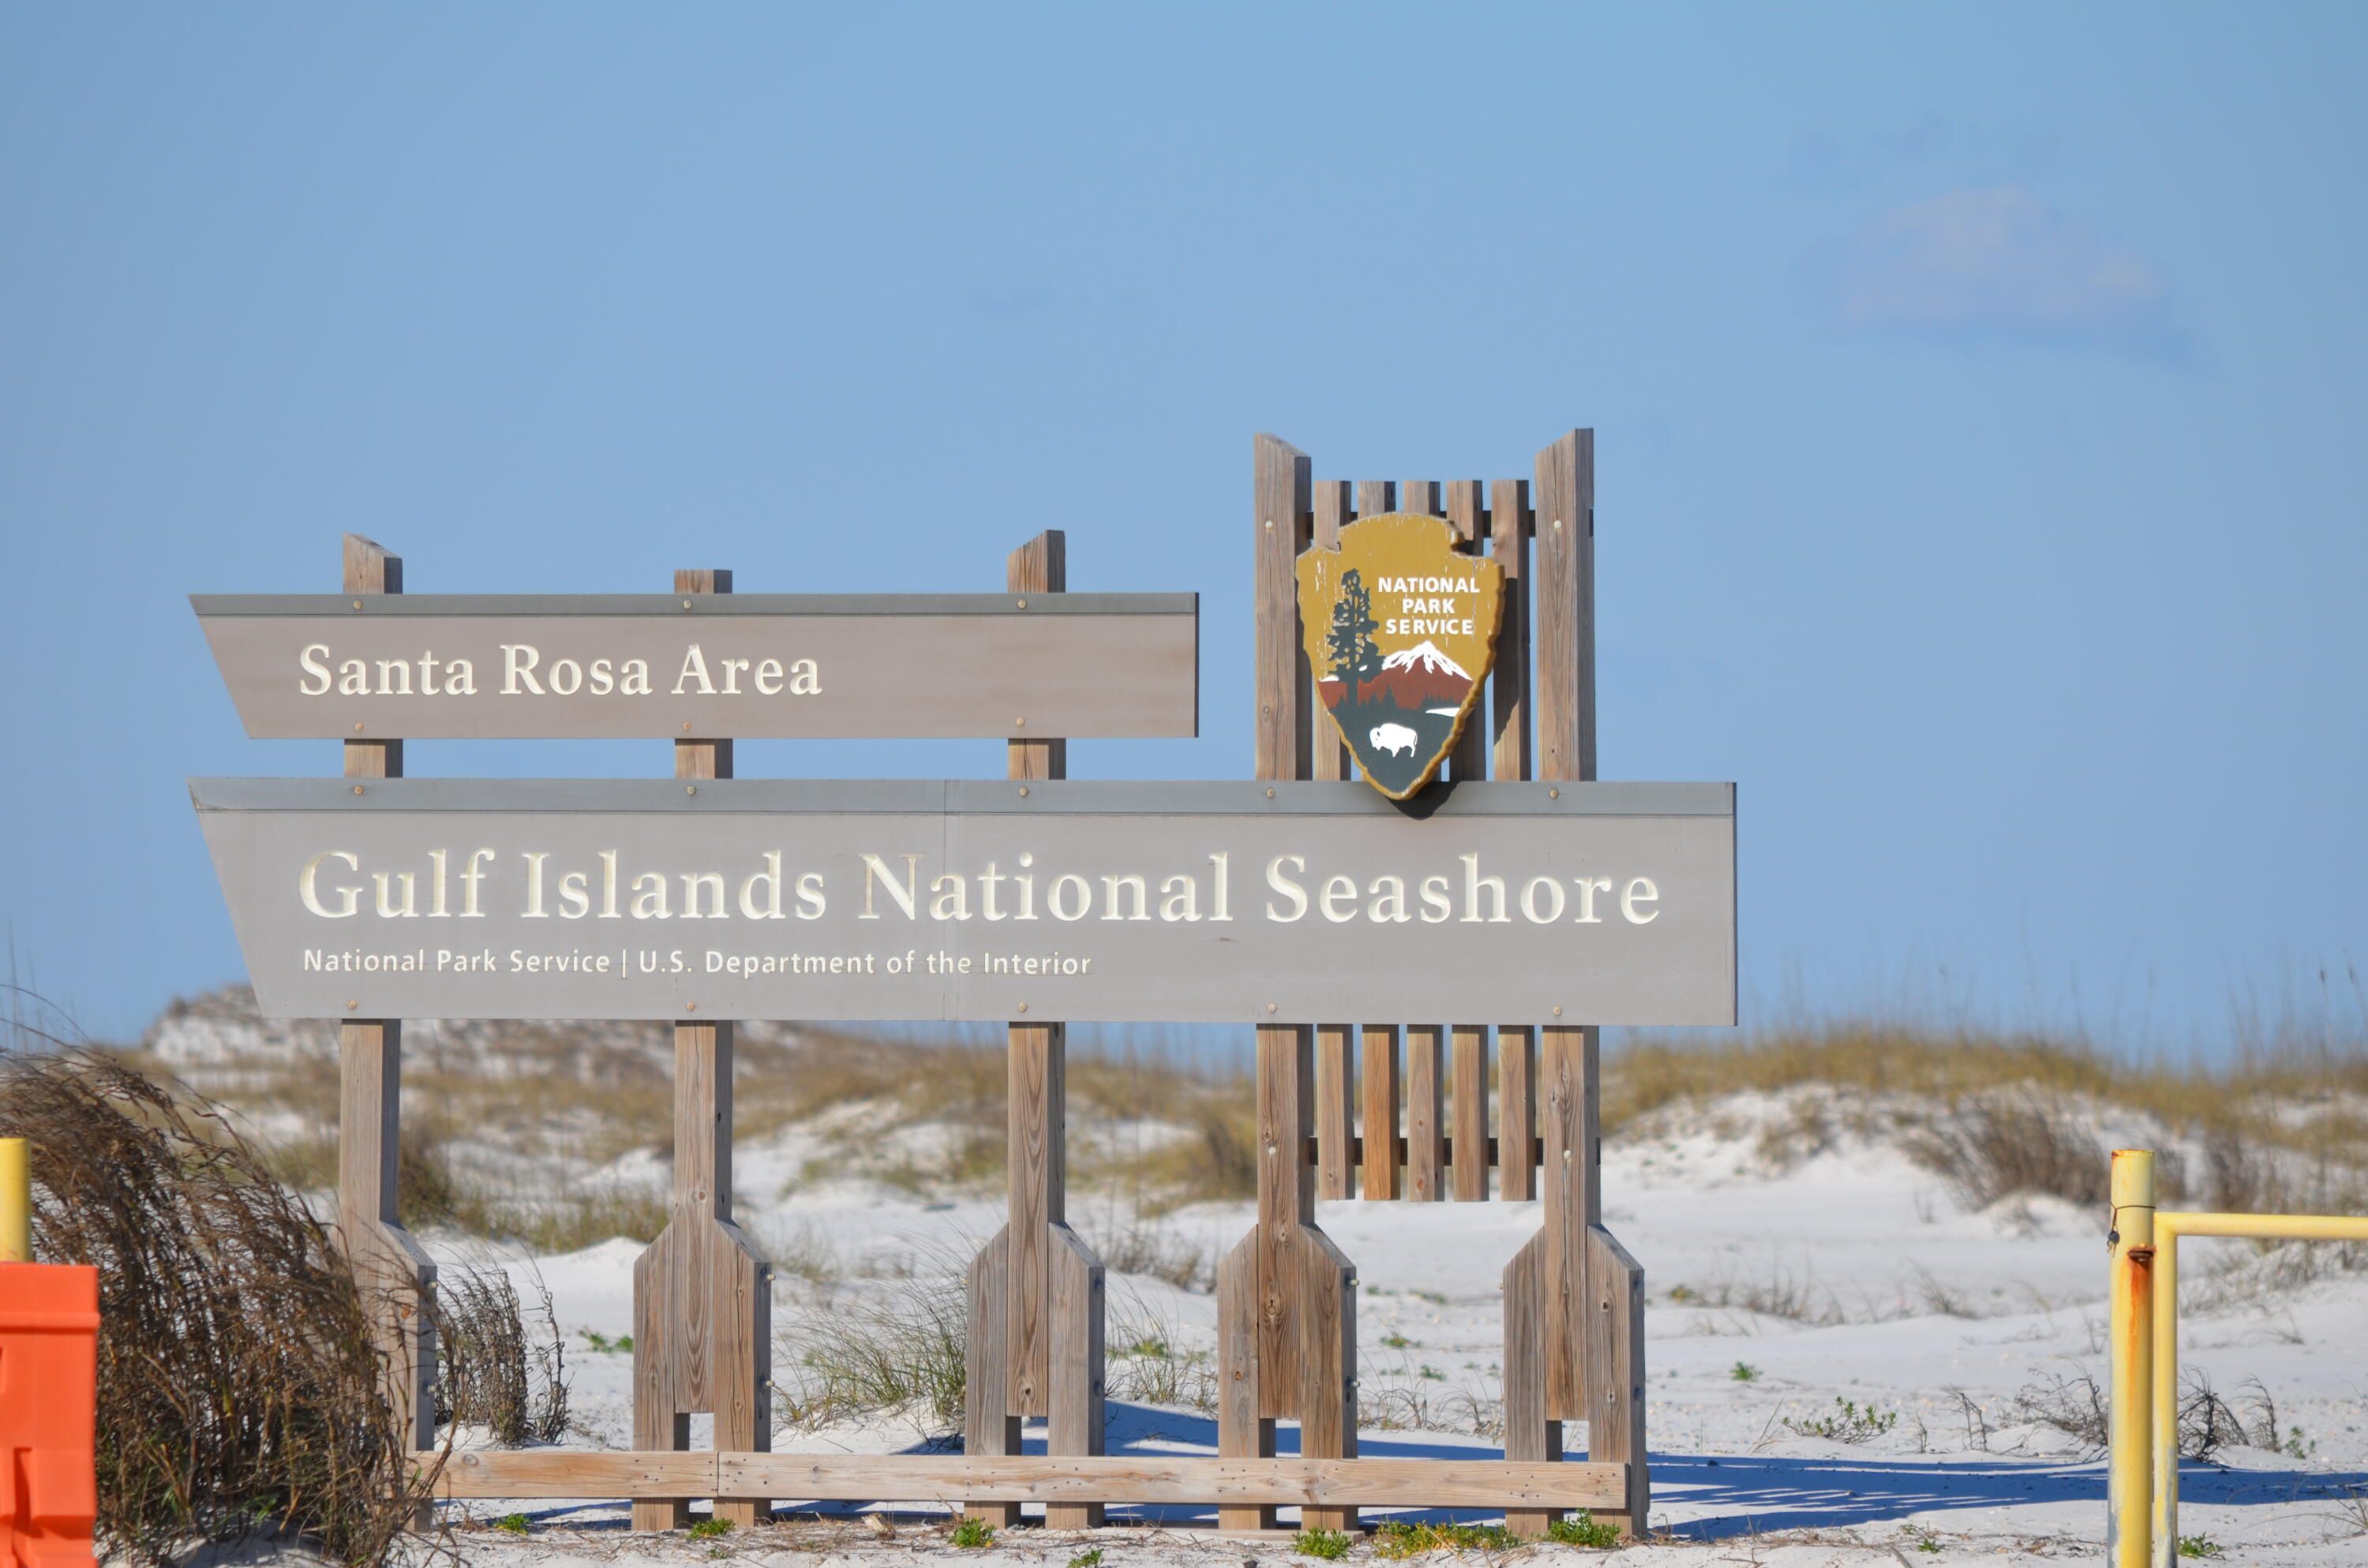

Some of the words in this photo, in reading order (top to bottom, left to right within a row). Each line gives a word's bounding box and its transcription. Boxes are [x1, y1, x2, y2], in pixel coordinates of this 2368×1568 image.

[1378, 577, 1480, 593] NATIONAL
[1402, 598, 1456, 614] PARK
[1386, 619, 1473, 634] SERVICE
[299, 644, 478, 695] Santa
[499, 644, 653, 695] Rosa
[670, 643, 822, 695] Area
[299, 848, 495, 919] Gulf
[520, 849, 826, 920] Islands
[857, 851, 1233, 922] National
[1265, 852, 1660, 924] Seashore
[304, 949, 424, 972] National
[437, 949, 496, 972] Park
[510, 949, 610, 973] Service
[639, 950, 692, 973] U.S.
[706, 950, 875, 979] Department
[886, 950, 916, 974] of
[927, 950, 972, 975] the
[984, 952, 1092, 975] Interior
